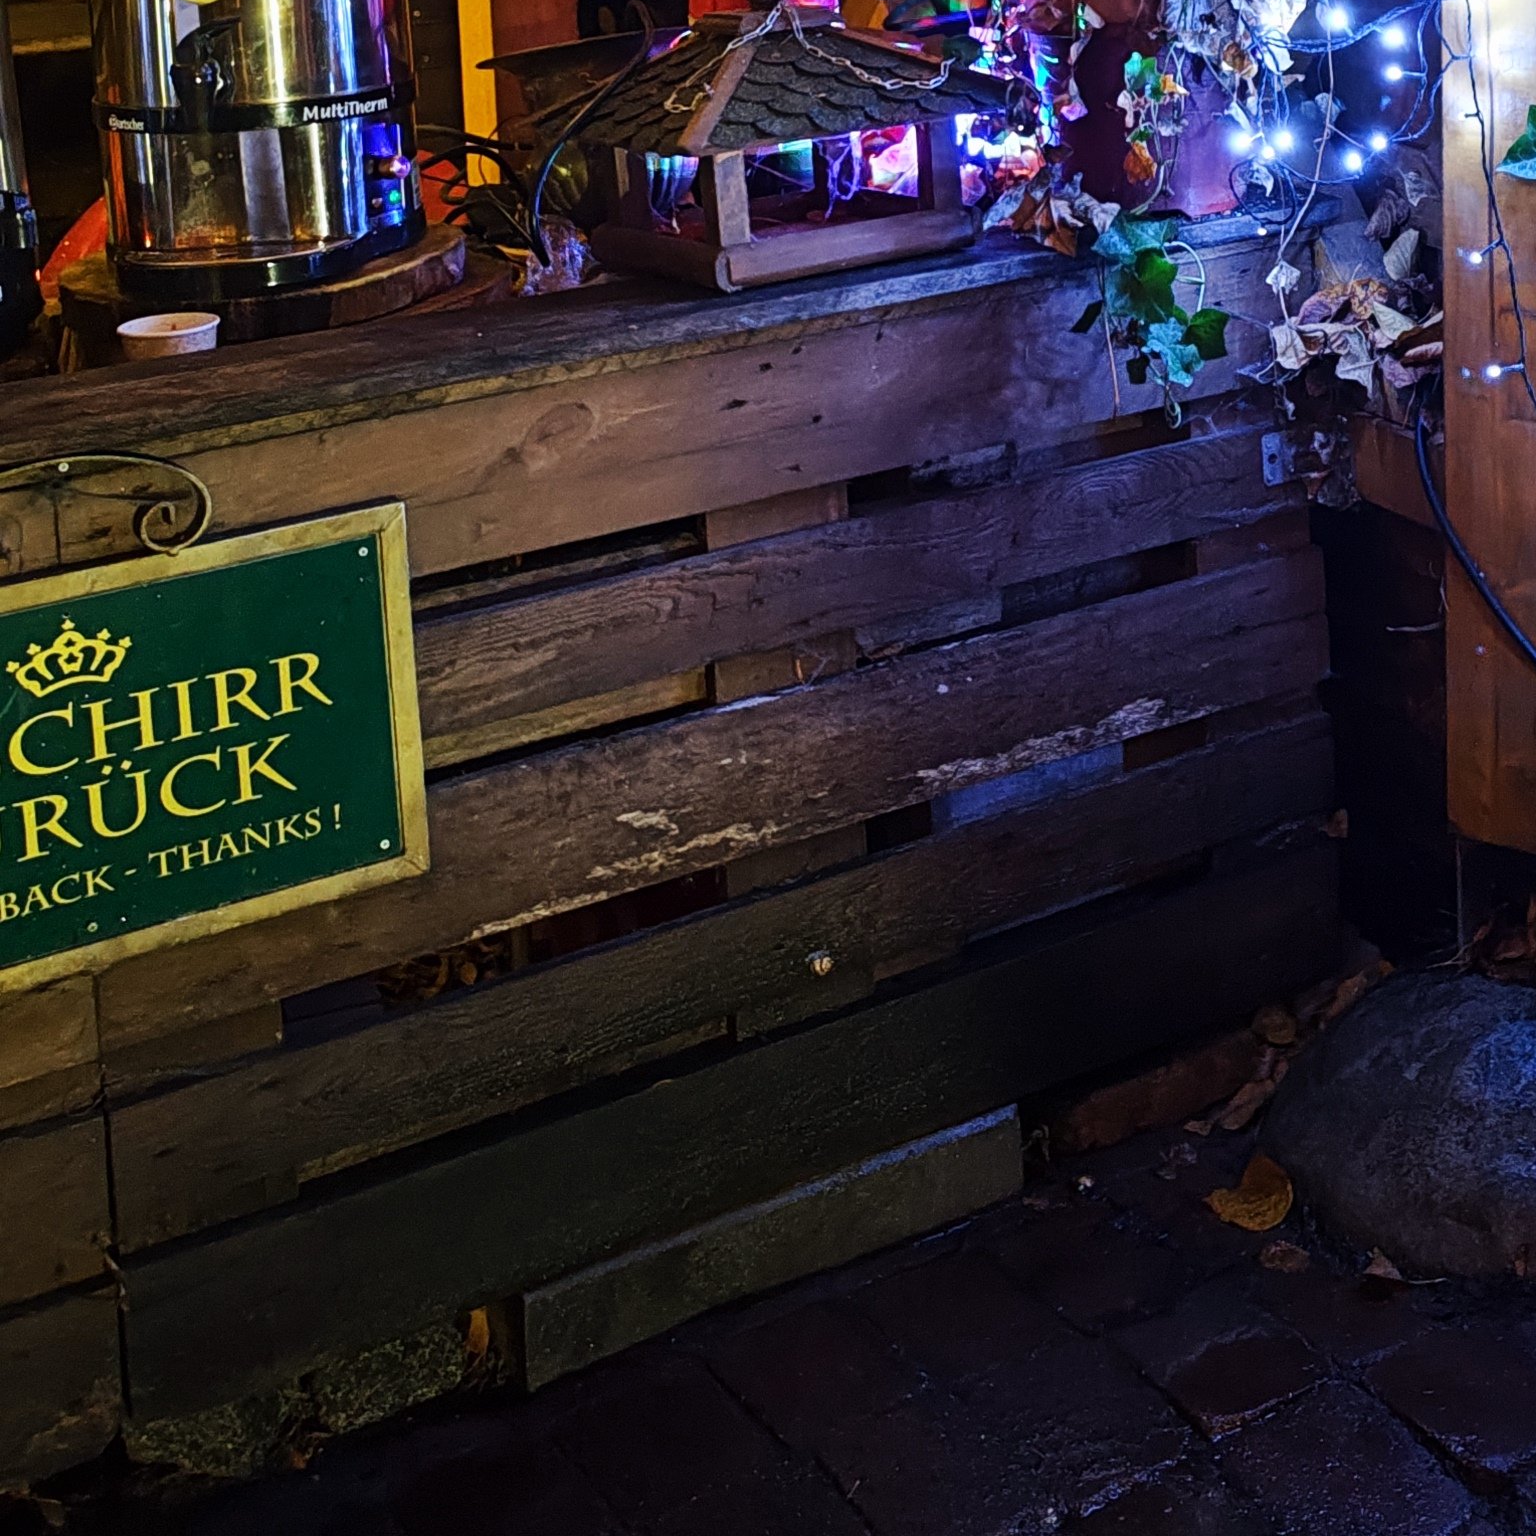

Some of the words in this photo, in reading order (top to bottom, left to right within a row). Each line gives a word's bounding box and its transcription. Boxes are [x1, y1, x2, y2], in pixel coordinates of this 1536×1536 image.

[302, 96, 388, 122] MultiTherm
[0, 733, 298, 863] RÜCK
[0, 865, 115, 922] BACK
[148, 806, 322, 879] THANKS
